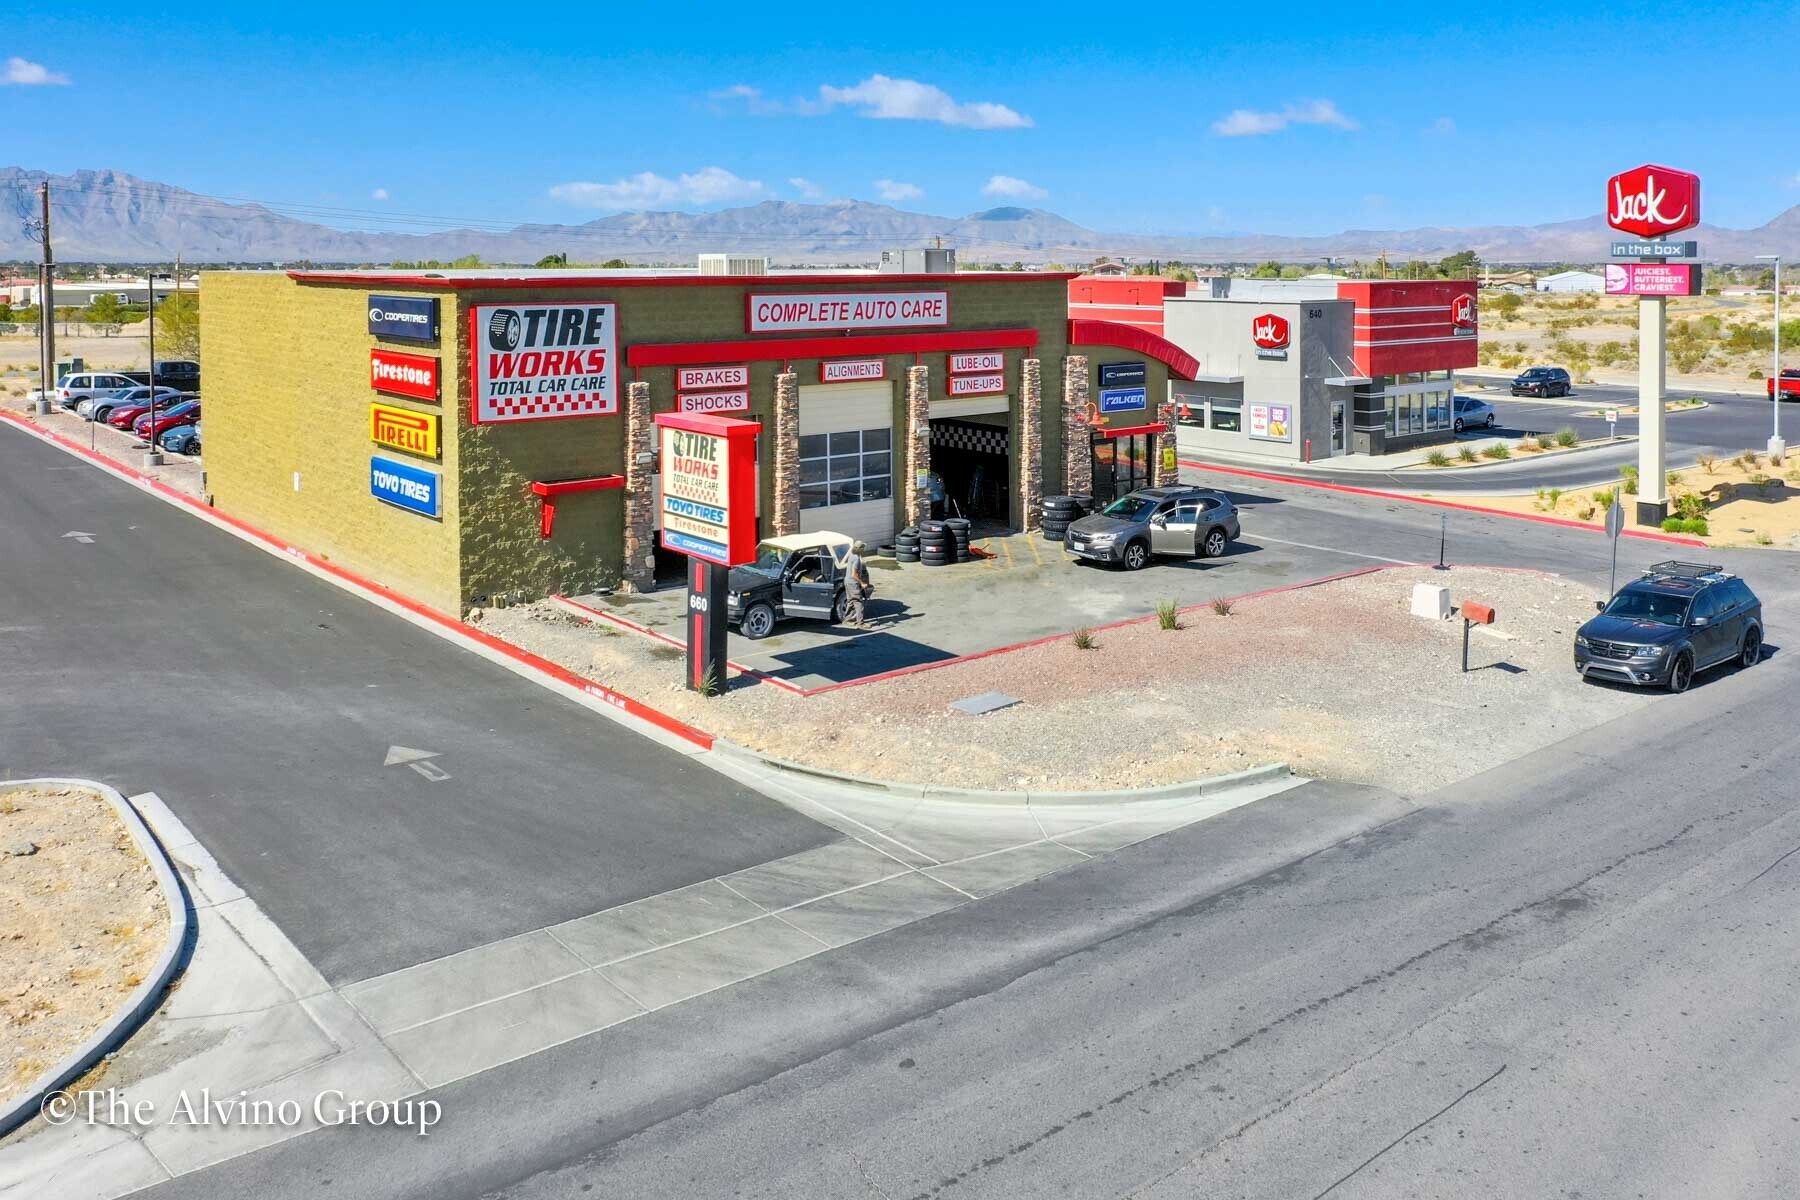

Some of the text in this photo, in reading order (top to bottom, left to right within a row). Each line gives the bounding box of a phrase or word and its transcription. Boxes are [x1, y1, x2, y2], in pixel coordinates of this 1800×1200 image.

[1610, 175, 1687, 224] Jack
[1613, 243, 1681, 255] in the box
[758, 299, 942, 323] COMPLETE AUTO CARE
[1309, 309, 1322, 319] 640
[523, 308, 605, 347] TIRE
[1254, 318, 1286, 342] Jack
[372, 358, 431, 386] Firestone
[489, 349, 607, 379] WORKS
[827, 363, 881, 378] ALIGNMENTS
[956, 356, 998, 369] LUBE-OIL
[489, 376, 606, 396] TOTAL CAR CARE
[685, 370, 741, 385] BRAKES
[954, 378, 1001, 391] TUNE-UPS
[685, 395, 742, 411] SHOCKS
[1106, 395, 1144, 406] FALKEN
[374, 409, 429, 452] PIRELLI
[685, 433, 718, 461] TIRE
[673, 456, 719, 480] WORKS
[373, 470, 430, 503] TOYO TIRES
[673, 473, 719, 491] TOTAL CAR CARE
[667, 498, 724, 523] TOYO TIRES
[674, 517, 719, 537] Firestone
[690, 594, 708, 611] 660
